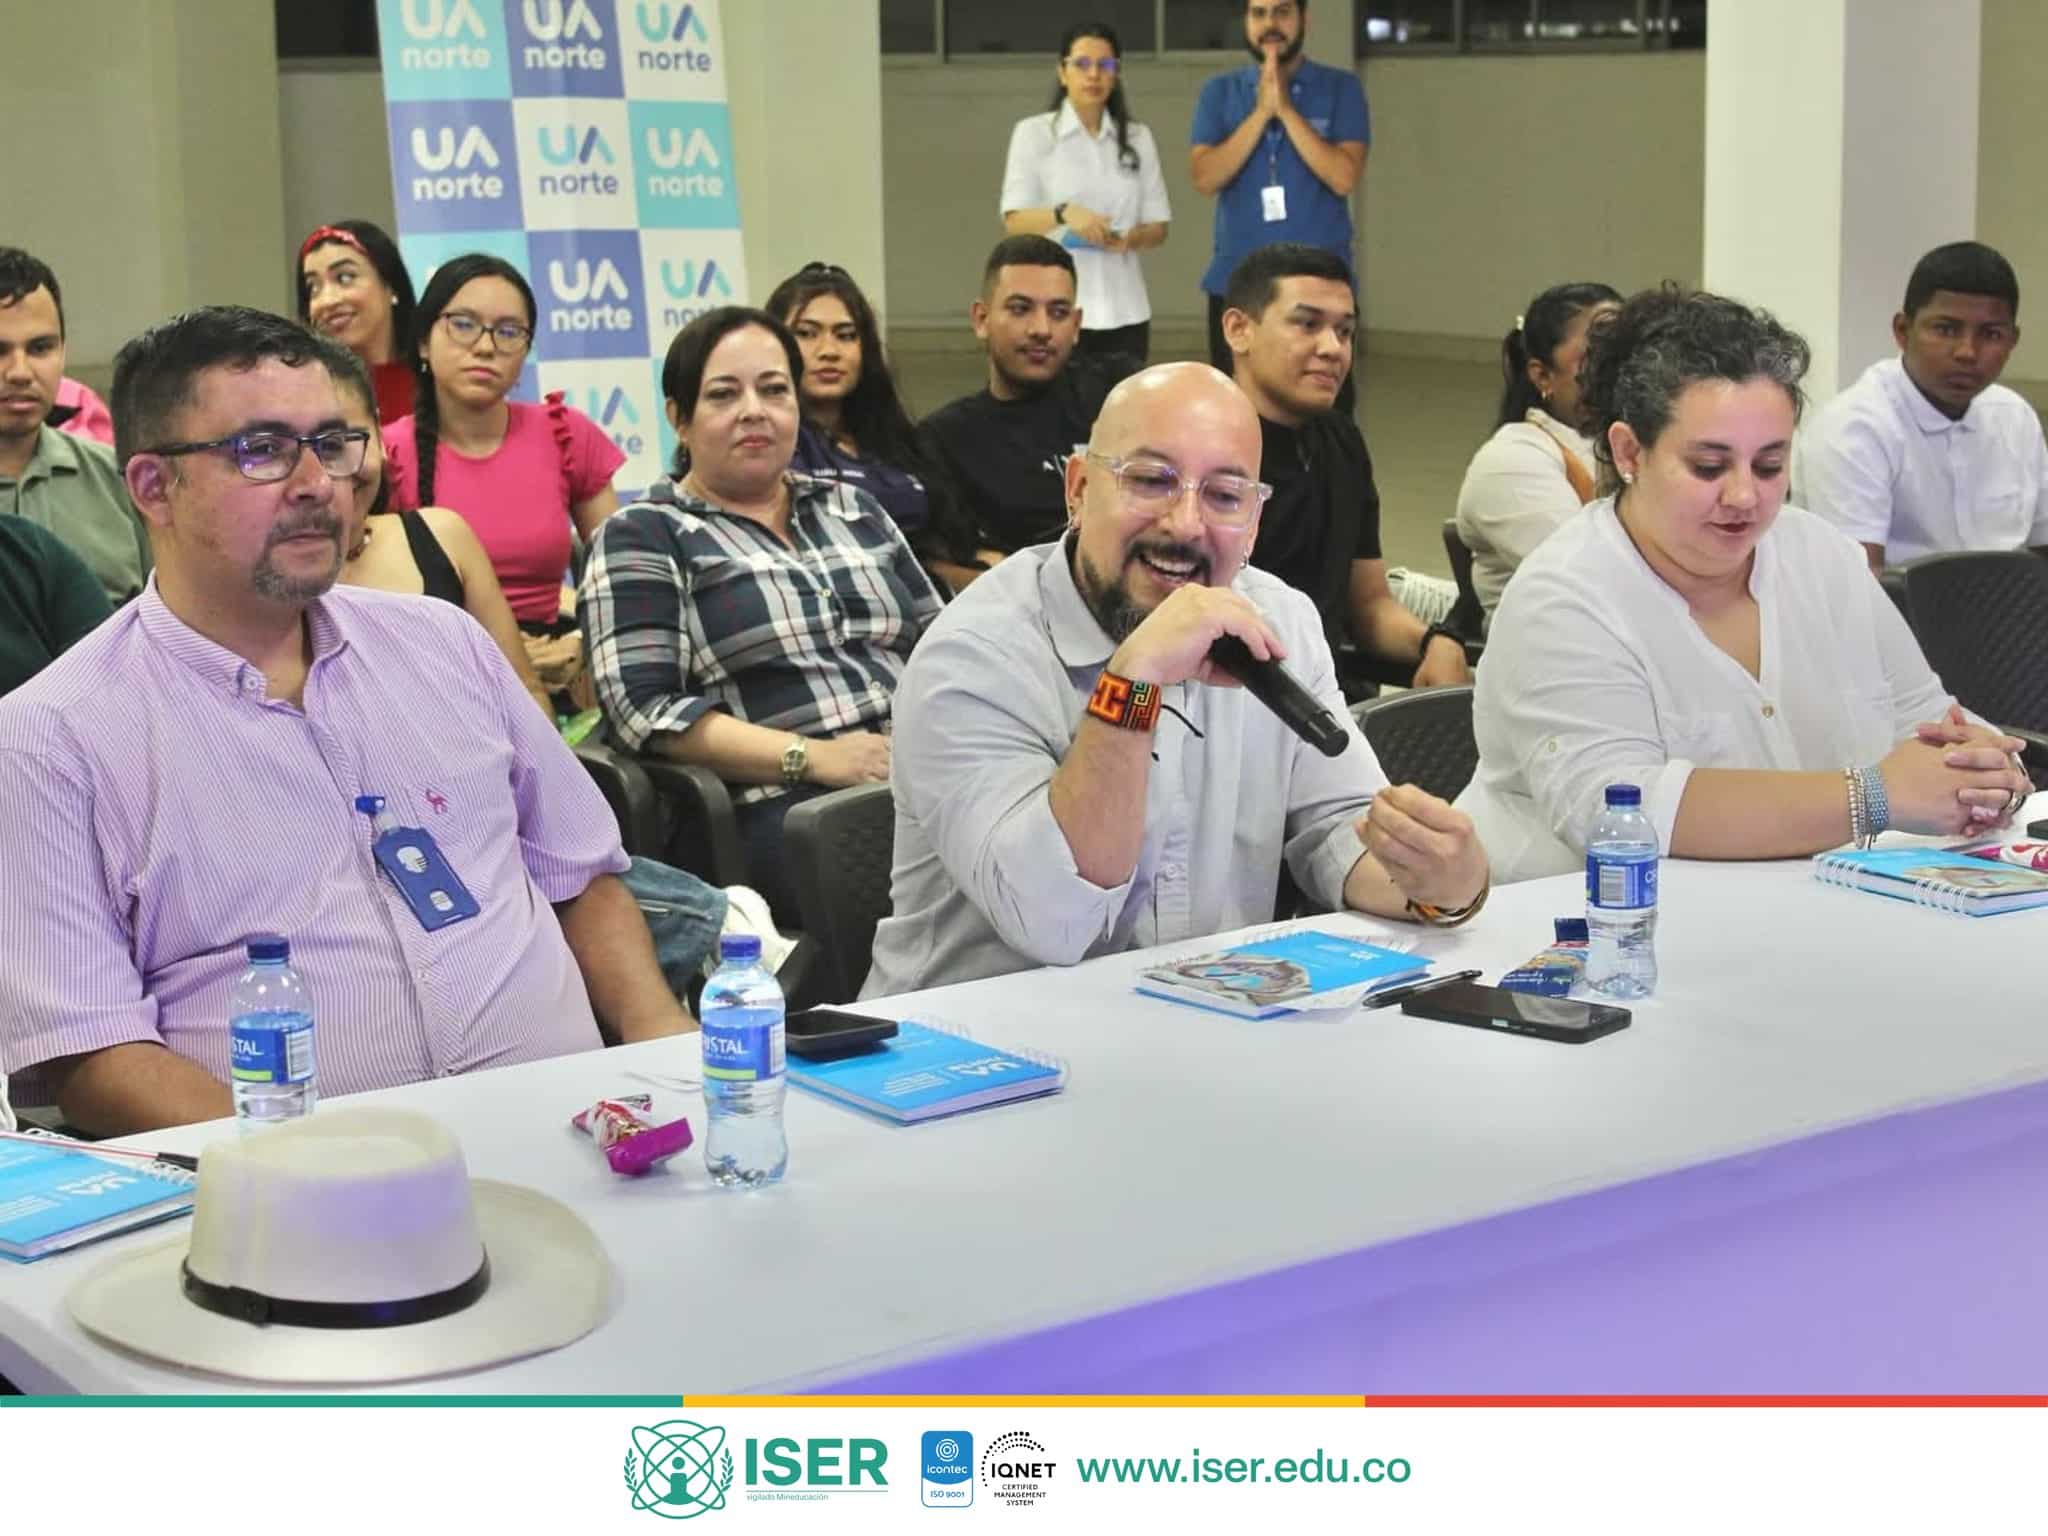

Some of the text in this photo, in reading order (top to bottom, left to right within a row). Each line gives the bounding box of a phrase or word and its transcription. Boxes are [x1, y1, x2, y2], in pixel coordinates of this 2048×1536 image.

[402, 0, 486, 40] UA
[524, 0, 603, 41] UA
[636, 3, 708, 42] UA
[402, 43, 491, 70] norte
[524, 42, 606, 70] norte
[638, 48, 711, 72] norte
[411, 125, 500, 171] UA
[538, 126, 615, 165] UA
[647, 127, 720, 168] UA
[412, 173, 503, 201] norte
[539, 170, 618, 195] norte
[648, 171, 723, 197] norte
[549, 258, 629, 302] UA
[660, 259, 732, 299] UA
[550, 303, 633, 332] norte
